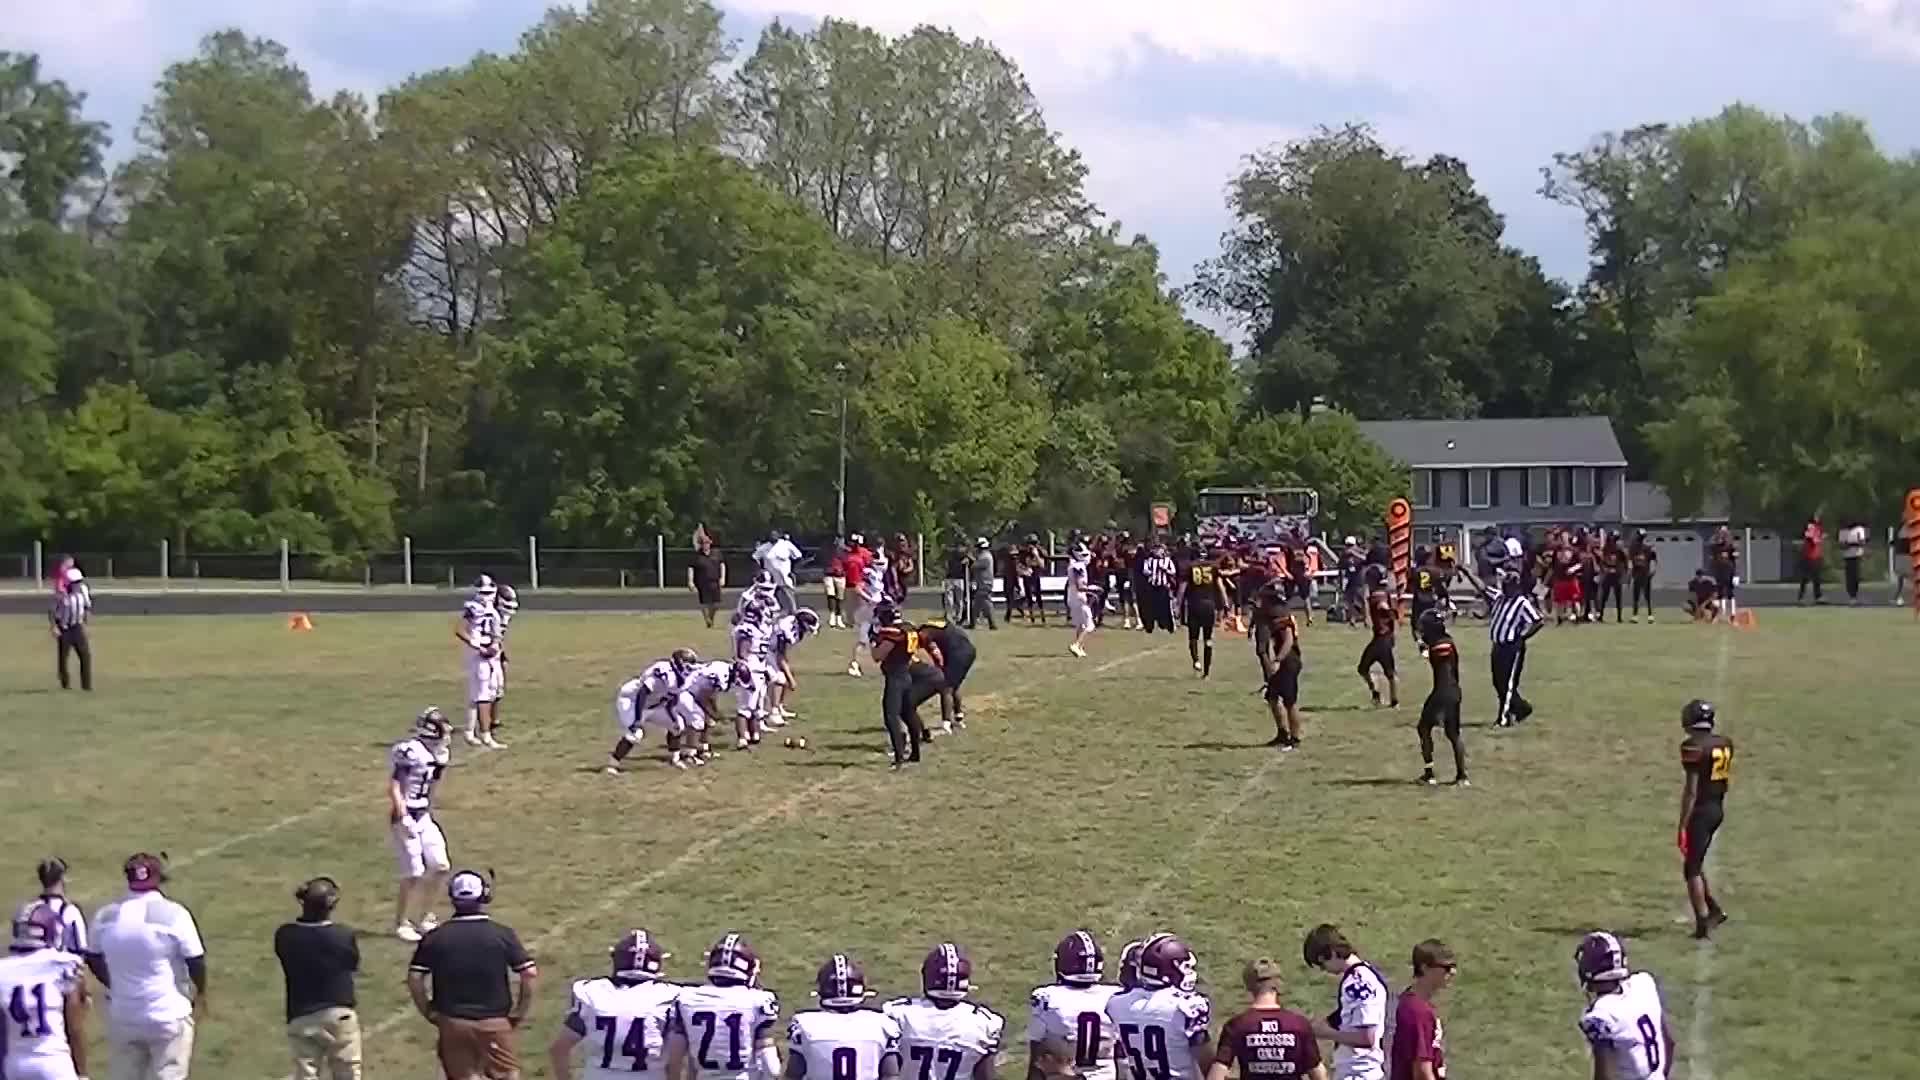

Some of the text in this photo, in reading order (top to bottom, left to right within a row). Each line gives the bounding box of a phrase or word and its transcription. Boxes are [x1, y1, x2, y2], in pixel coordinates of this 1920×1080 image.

[1420, 571, 1431, 589] 2
[9, 983, 53, 1037] 41
[596, 1016, 649, 1070] 74
[692, 1012, 743, 1070] 21
[1119, 1023, 1171, 1080] 59
[1637, 1014, 1660, 1072] 8
